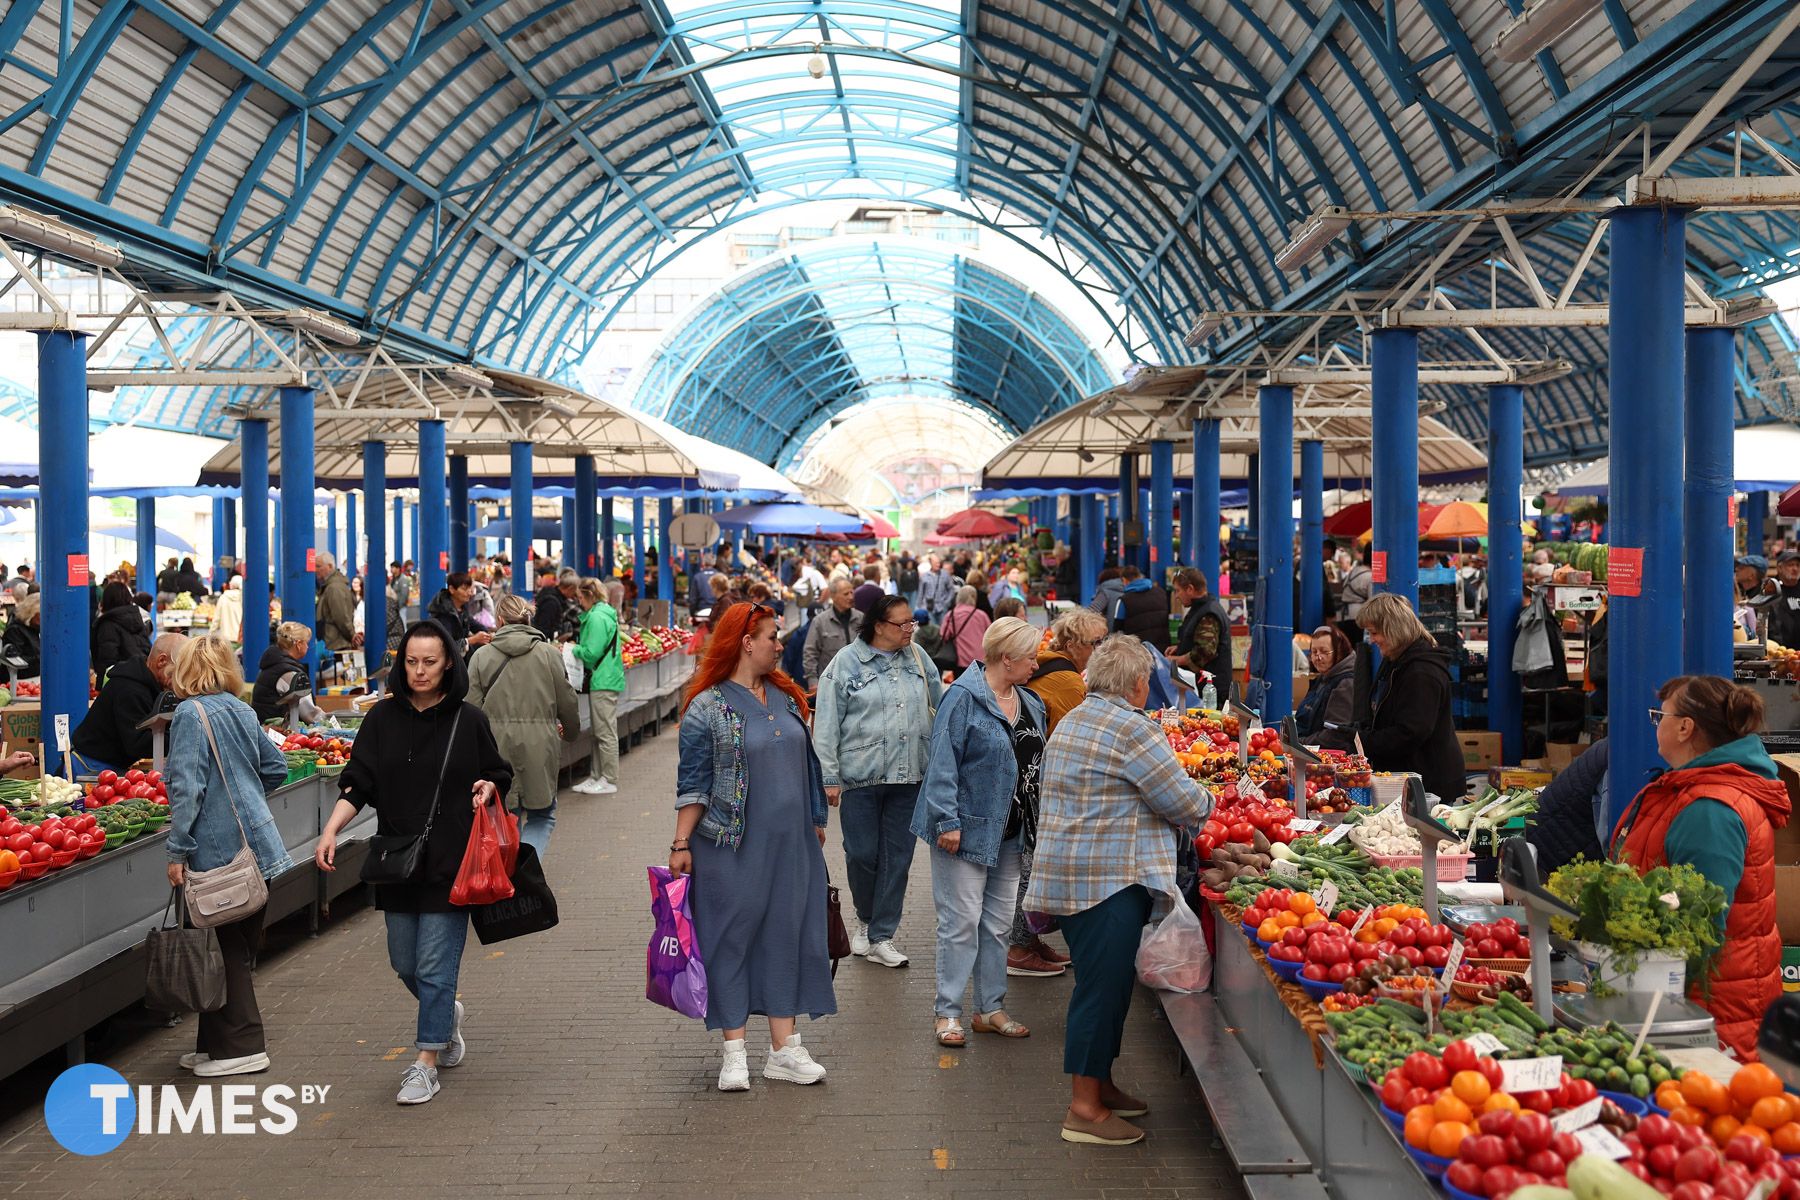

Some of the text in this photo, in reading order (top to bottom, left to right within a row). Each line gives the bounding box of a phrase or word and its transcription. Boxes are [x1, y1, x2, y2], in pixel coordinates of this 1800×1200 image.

[7, 713, 40, 725] Globa
[9, 724, 40, 738] Villa
[28, 896, 35, 913] 13
